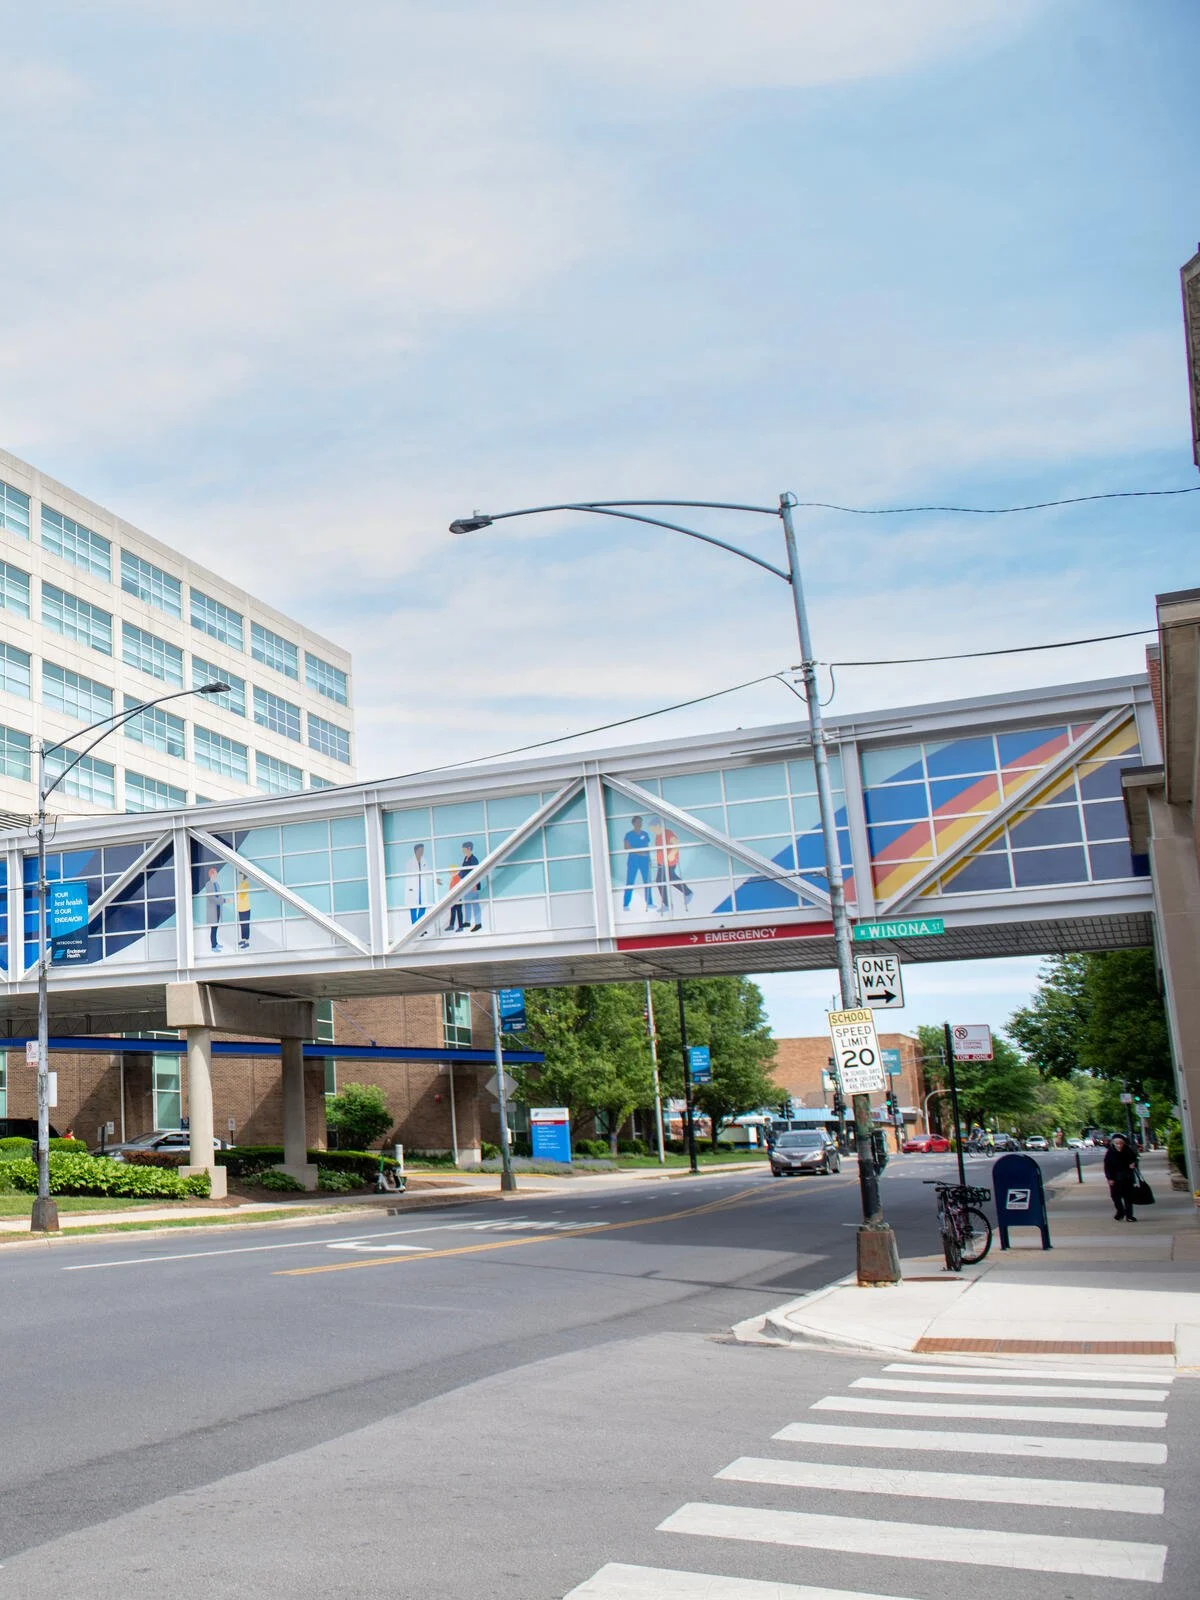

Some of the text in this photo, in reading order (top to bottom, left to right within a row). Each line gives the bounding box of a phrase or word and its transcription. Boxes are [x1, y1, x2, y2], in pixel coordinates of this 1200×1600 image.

[54, 915, 83, 924] ENDEAVOR
[704, 927, 777, 942] EMERGENCY
[868, 922, 930, 938] WINONA
[931, 922, 940, 931] ST
[861, 959, 895, 973] ONE
[862, 974, 896, 988] WAY
[831, 1011, 871, 1024] SCHOOL
[835, 1025, 872, 1038] SPEED
[841, 1036, 869, 1048] LIMIT
[841, 1048, 875, 1069] 20
